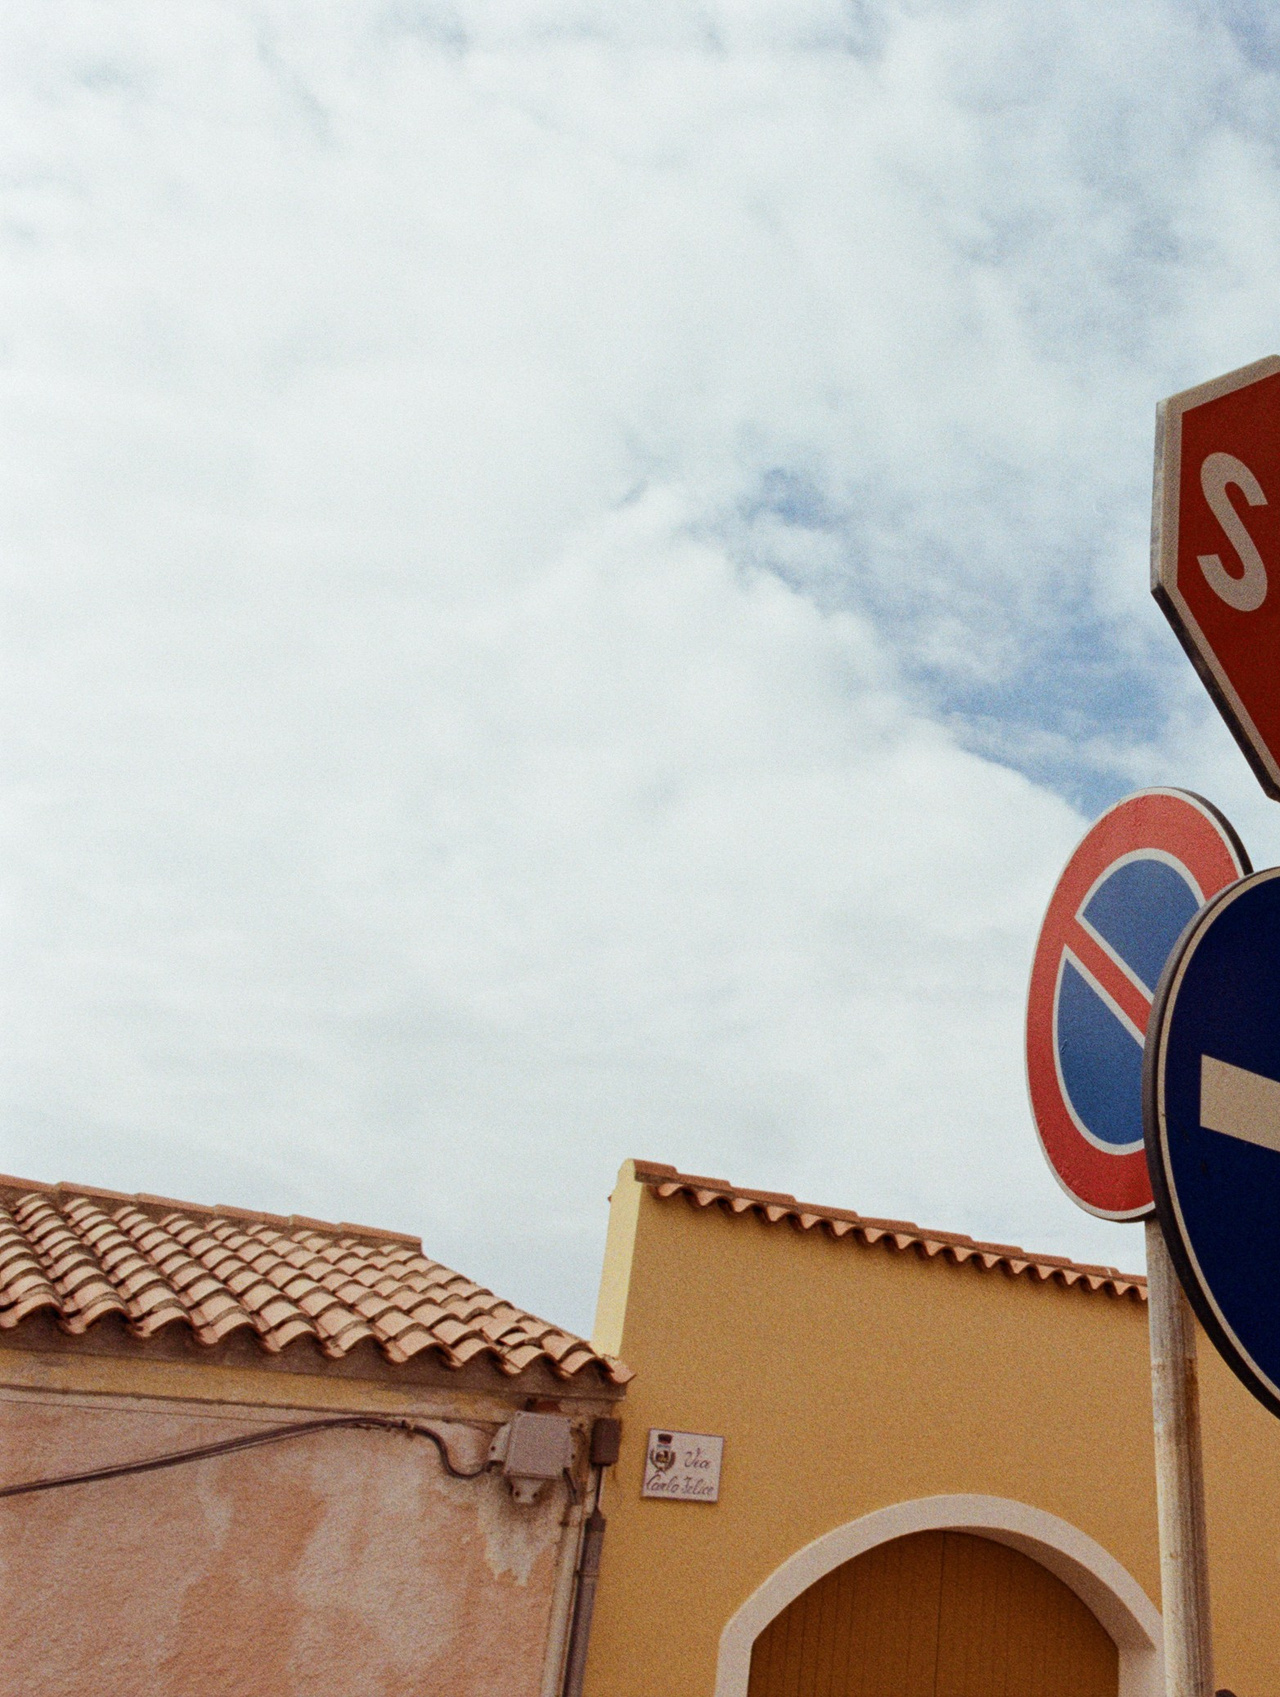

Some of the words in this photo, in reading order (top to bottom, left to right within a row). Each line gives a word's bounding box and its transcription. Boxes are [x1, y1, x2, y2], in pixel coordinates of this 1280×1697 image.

[684, 1447, 710, 1469] Via
[646, 1473, 680, 1493] Carlo
[681, 1476, 714, 1495] Felice
